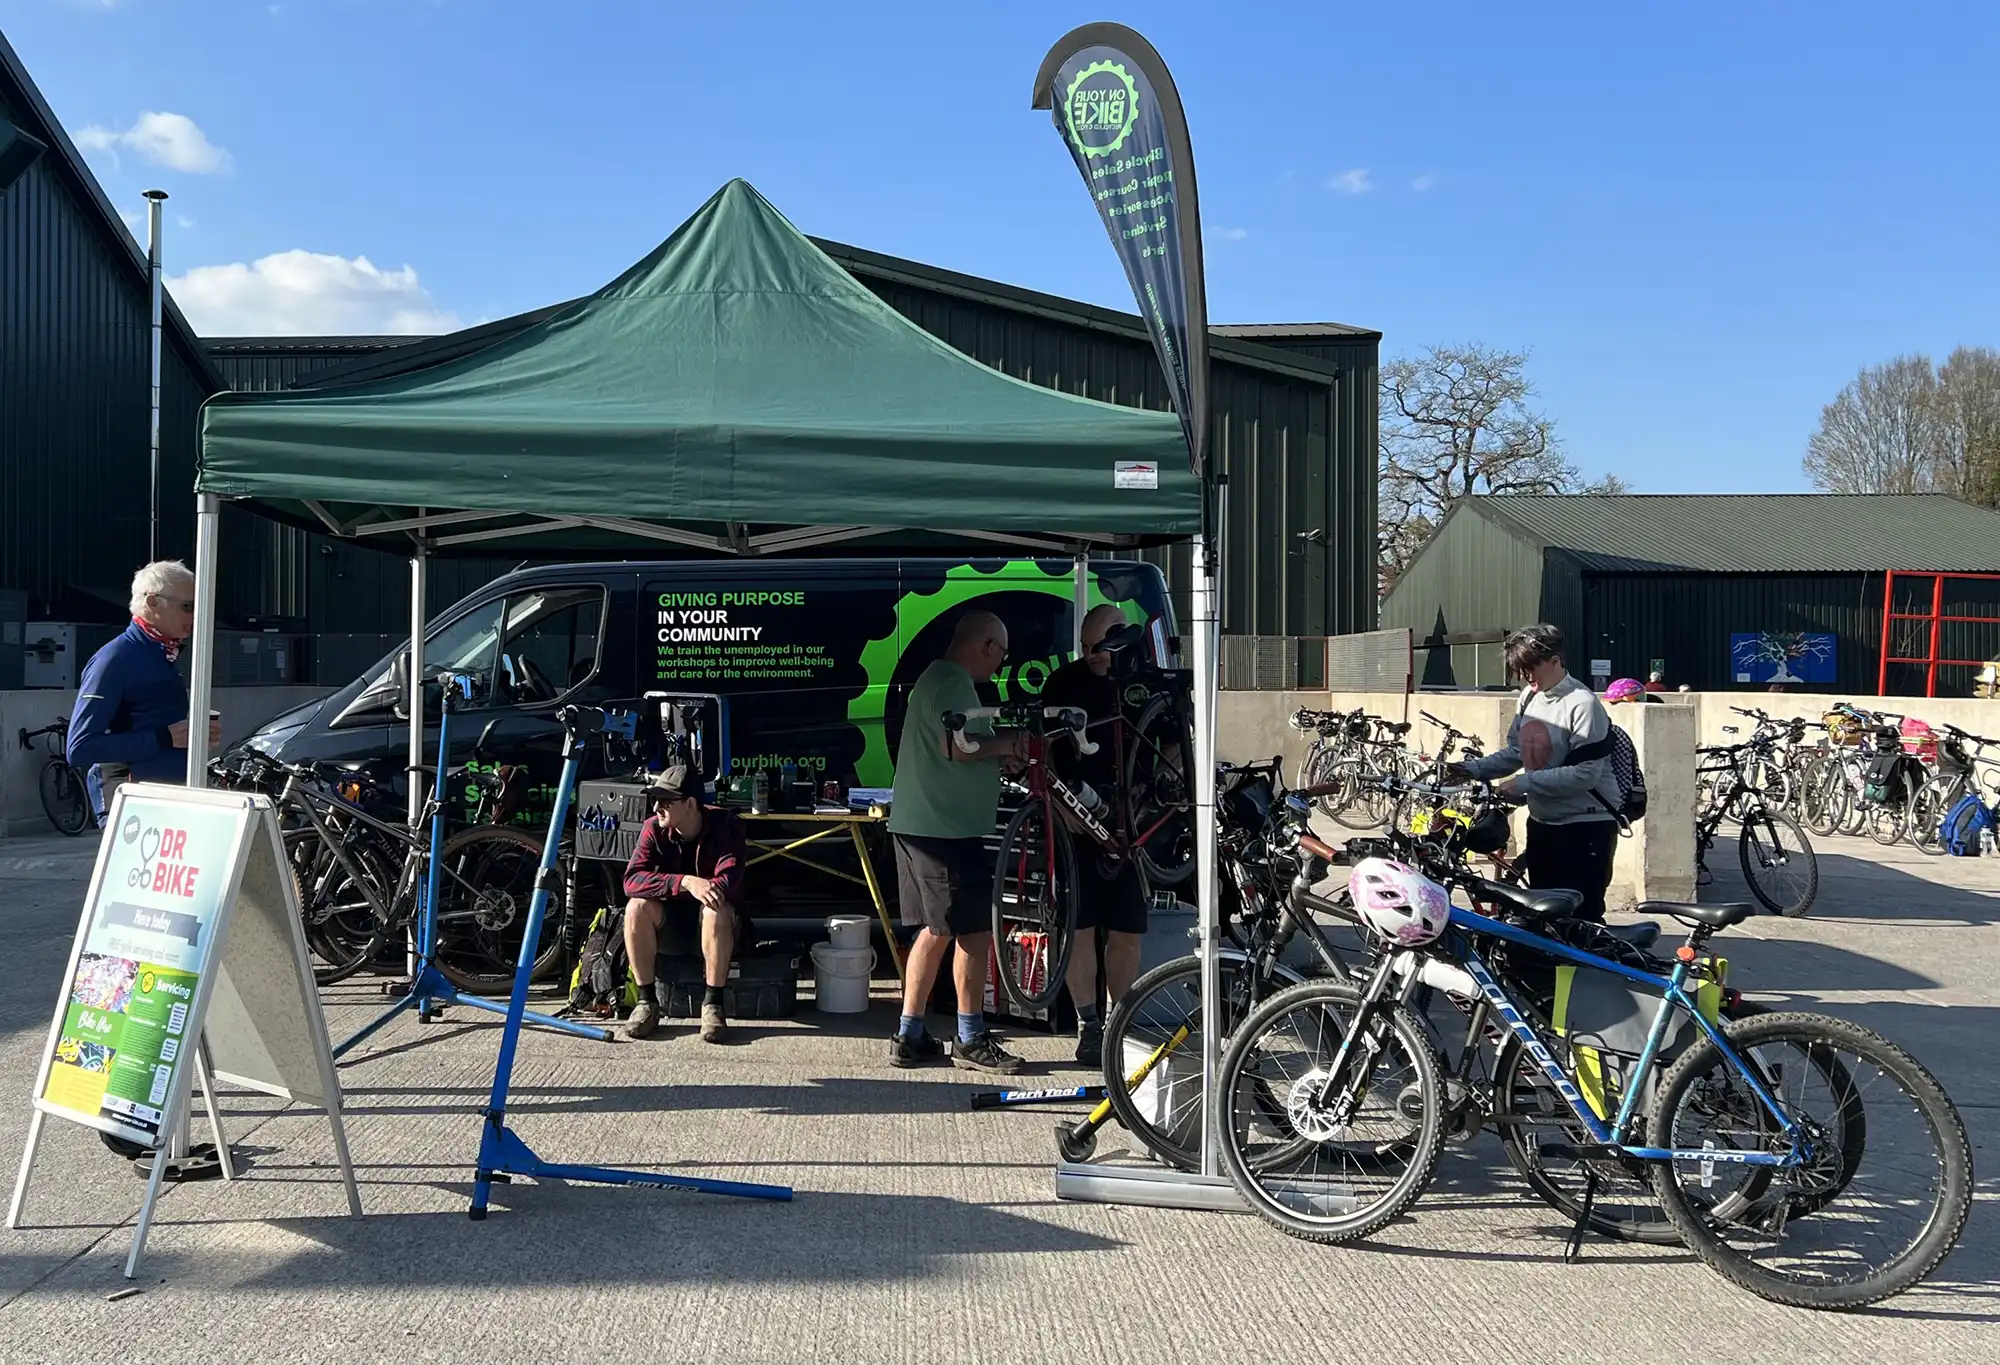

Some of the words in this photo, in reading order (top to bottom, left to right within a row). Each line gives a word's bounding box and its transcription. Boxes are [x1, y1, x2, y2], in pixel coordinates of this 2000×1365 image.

[658, 593, 718, 606] GIVING
[722, 592, 805, 606] PURPOSE
[658, 611, 674, 624] IN
[679, 610, 728, 624] YOUR
[658, 627, 762, 642] COMMUNITY
[658, 646, 674, 655] We
[677, 646, 701, 655] train
[704, 646, 721, 654] the
[724, 645, 790, 656] unemployed
[793, 645, 803, 654] in
[806, 646, 824, 654] our
[657, 658, 716, 669] workshops
[719, 658, 730, 666] to
[732, 657, 776, 668] improve
[779, 656, 834, 668] well-being
[657, 669, 677, 678] and
[706, 669, 721, 678] for
[724, 668, 740, 678] the
[743, 668, 814, 678] environment.
[1052, 778, 1110, 841] FOCUS
[160, 828, 188, 860] DR
[152, 862, 200, 898] BIKE
[133, 909, 150, 928] Here
[150, 911, 172, 934] today
[156, 979, 190, 1000] Servicing
[1006, 1089, 1043, 1100] Park
[1045, 1086, 1080, 1098] Tool
